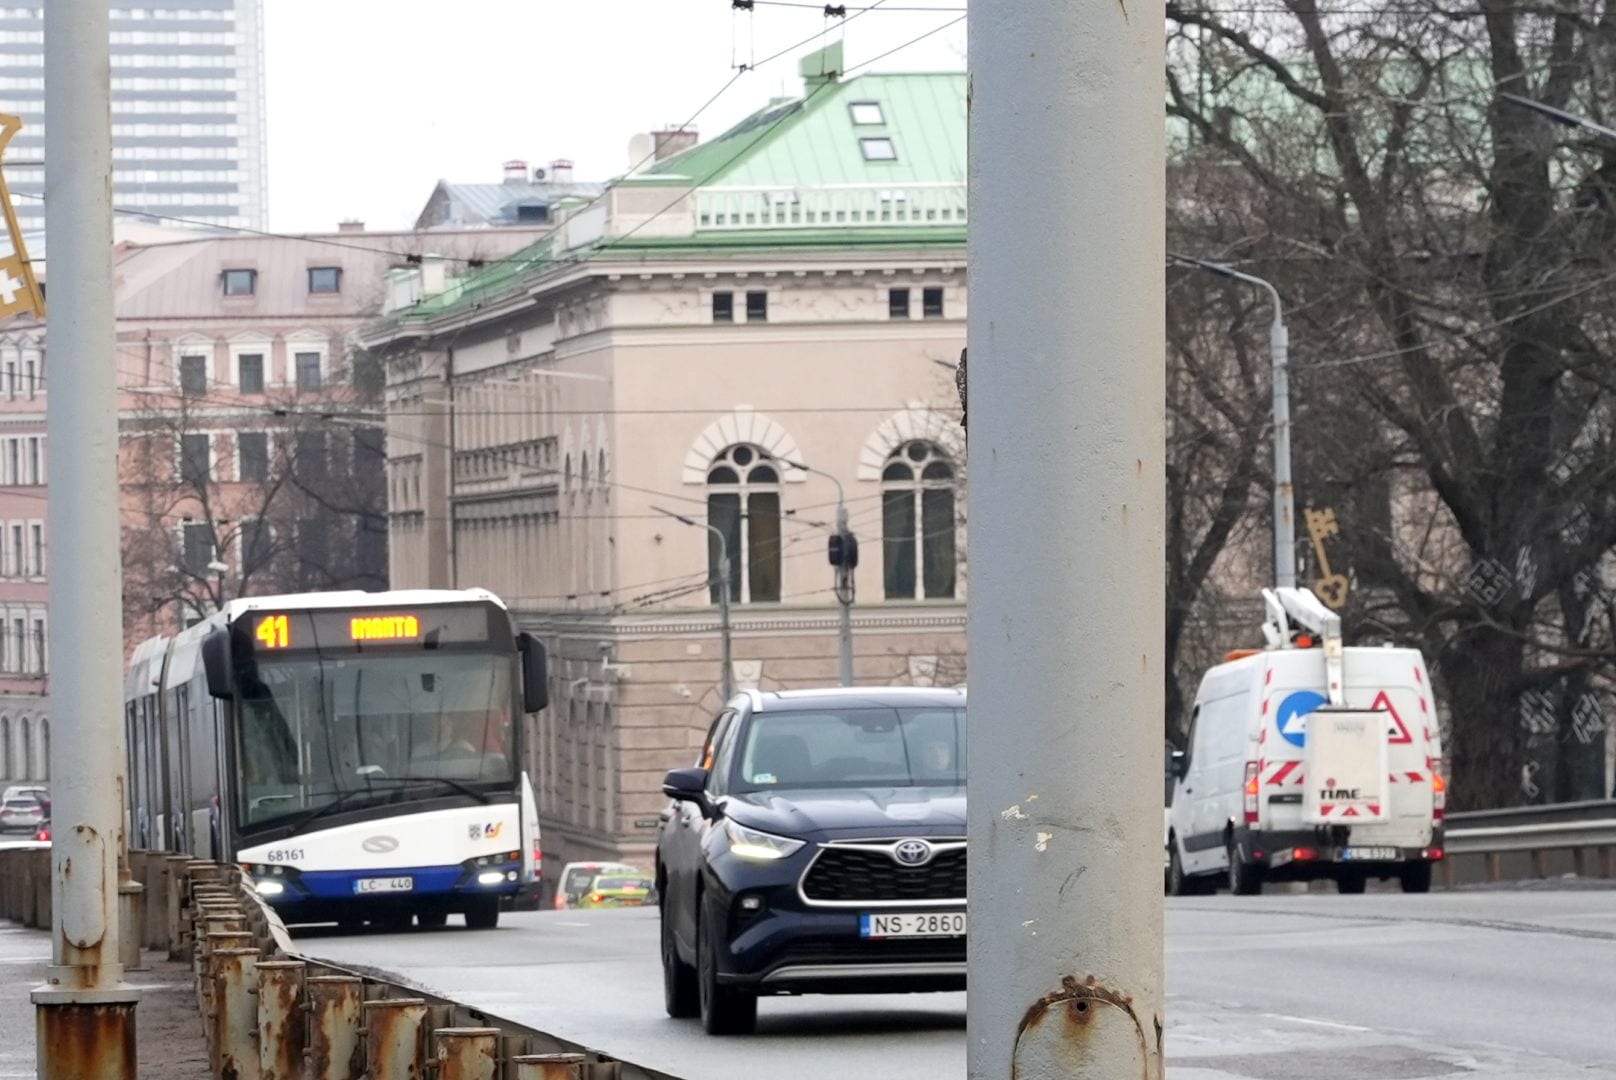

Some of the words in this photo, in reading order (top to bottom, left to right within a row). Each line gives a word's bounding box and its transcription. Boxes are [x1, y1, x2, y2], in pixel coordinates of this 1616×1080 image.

[256, 615, 289, 648] 41
[267, 849, 305, 862] 68161
[875, 915, 963, 933] NS-2860
